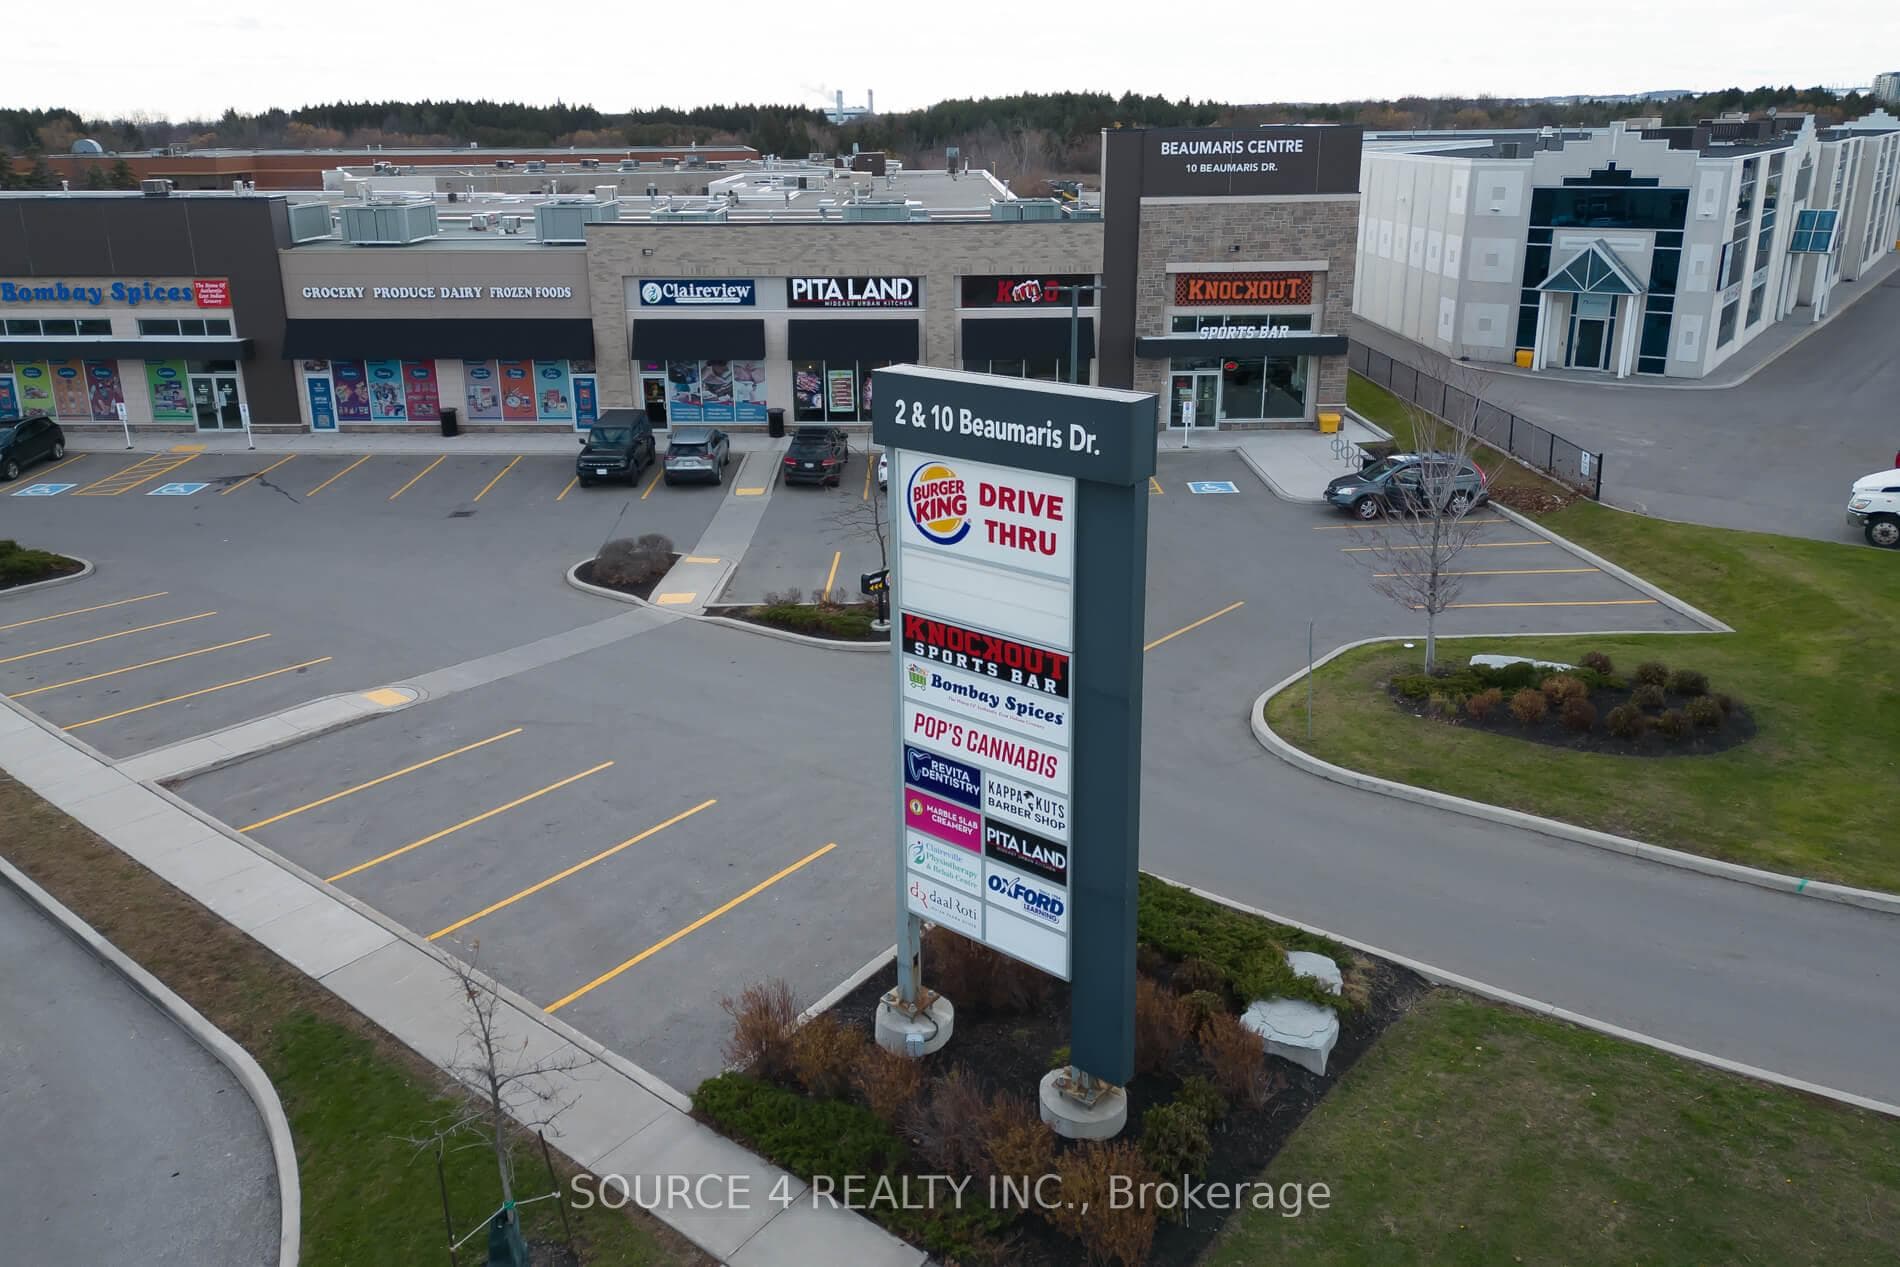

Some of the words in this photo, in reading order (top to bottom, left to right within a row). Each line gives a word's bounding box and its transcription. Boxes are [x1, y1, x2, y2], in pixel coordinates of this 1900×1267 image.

[1161, 140, 1244, 155] BEAUMARIS
[1247, 139, 1304, 153] CENTRE
[1186, 164, 1197, 173] 10
[1200, 162, 1258, 173] BEAUMARIS
[1261, 162, 1278, 171] DR.
[0, 281, 102, 305] Bombay
[110, 281, 193, 305] Spices
[302, 286, 365, 298] GROCERY
[373, 286, 436, 298] PRODUCE
[440, 286, 483, 298] DAIRY
[489, 286, 533, 298] FROZEN
[535, 286, 572, 299] FOODS
[662, 283, 751, 298] Claireview
[792, 278, 844, 300] PITA
[847, 278, 913, 300] LAND
[1188, 279, 1302, 300] KNOCKOUT
[1199, 326, 1255, 340] SPORTS
[1259, 325, 1289, 339] BAR
[895, 399, 906, 425] 2
[911, 401, 926, 428] &
[931, 404, 954, 432] 10
[959, 408, 1063, 449] Beaumaris
[1069, 423, 1100, 456] Dr.
[913, 479, 965, 502] BURGER
[979, 482, 1064, 521] DRIVE
[916, 495, 967, 523] KING
[984, 519, 1057, 556] THRU
[905, 613, 1069, 680] KNOCKOUT
[914, 642, 998, 677] SPORTS
[1011, 668, 1057, 694] BAR
[931, 673, 1000, 708] Bombay
[1005, 695, 1064, 725] Spices
[914, 713, 963, 747] POP'S
[967, 730, 1058, 779] CANNABIS
[921, 767, 980, 796] DENTISTRY
[931, 760, 970, 783] REVITA
[988, 780, 1023, 804] KAPPA
[1036, 796, 1065, 819] KUTS
[926, 804, 957, 821] MARBLE
[959, 816, 978, 829] SLAB
[931, 814, 974, 836] CREAMERY
[988, 797, 1031, 819] BARBER
[1034, 813, 1066, 831] SHOP
[986, 827, 1020, 853] PITA
[1022, 840, 1066, 869] LAND
[988, 874, 1064, 917] OXFORD
[1023, 903, 1057, 921] LEARNING
